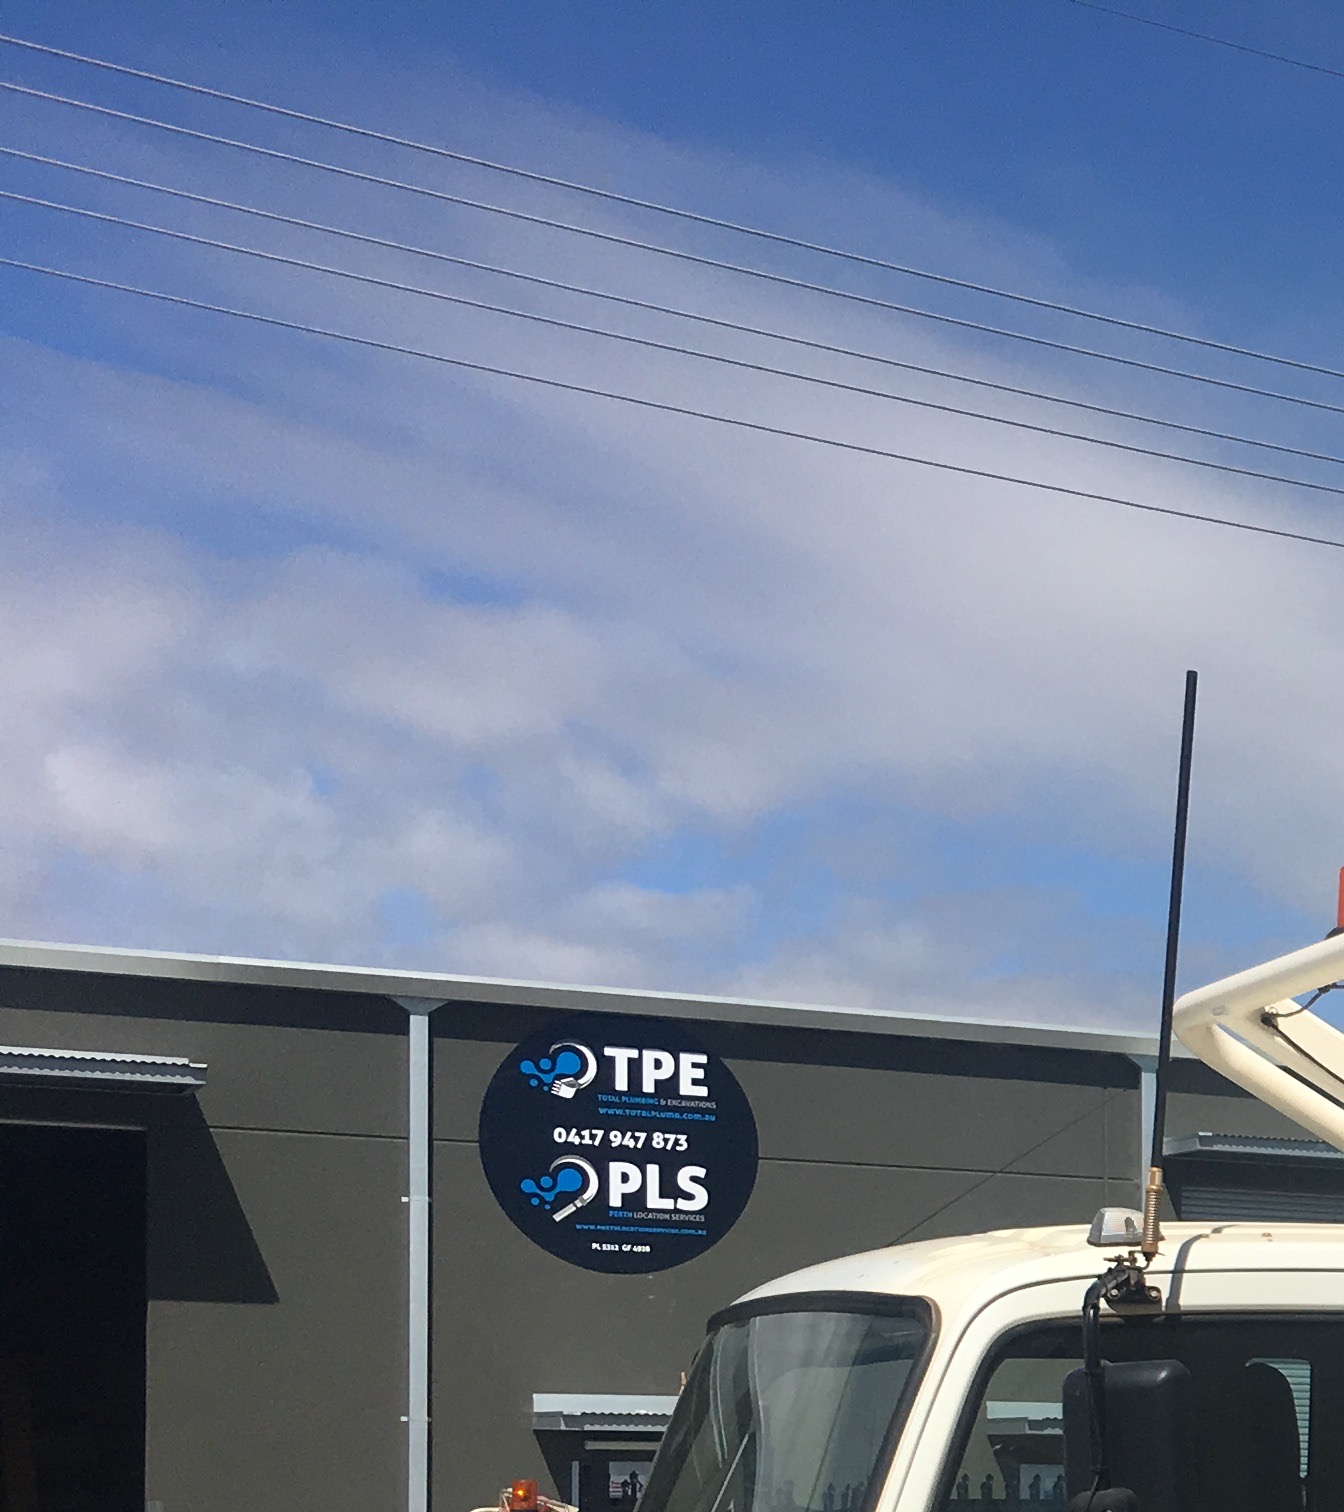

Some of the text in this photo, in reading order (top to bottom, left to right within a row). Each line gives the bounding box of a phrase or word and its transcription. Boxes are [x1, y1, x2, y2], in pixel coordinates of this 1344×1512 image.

[603, 1046, 709, 1097] TPE
[667, 1099, 717, 1109] EXCAVATIONS
[553, 1127, 688, 1151] 0417 947 873
[608, 1161, 709, 1211] PLS
[609, 1210, 705, 1222] PERTH LOCATION SERVICES
